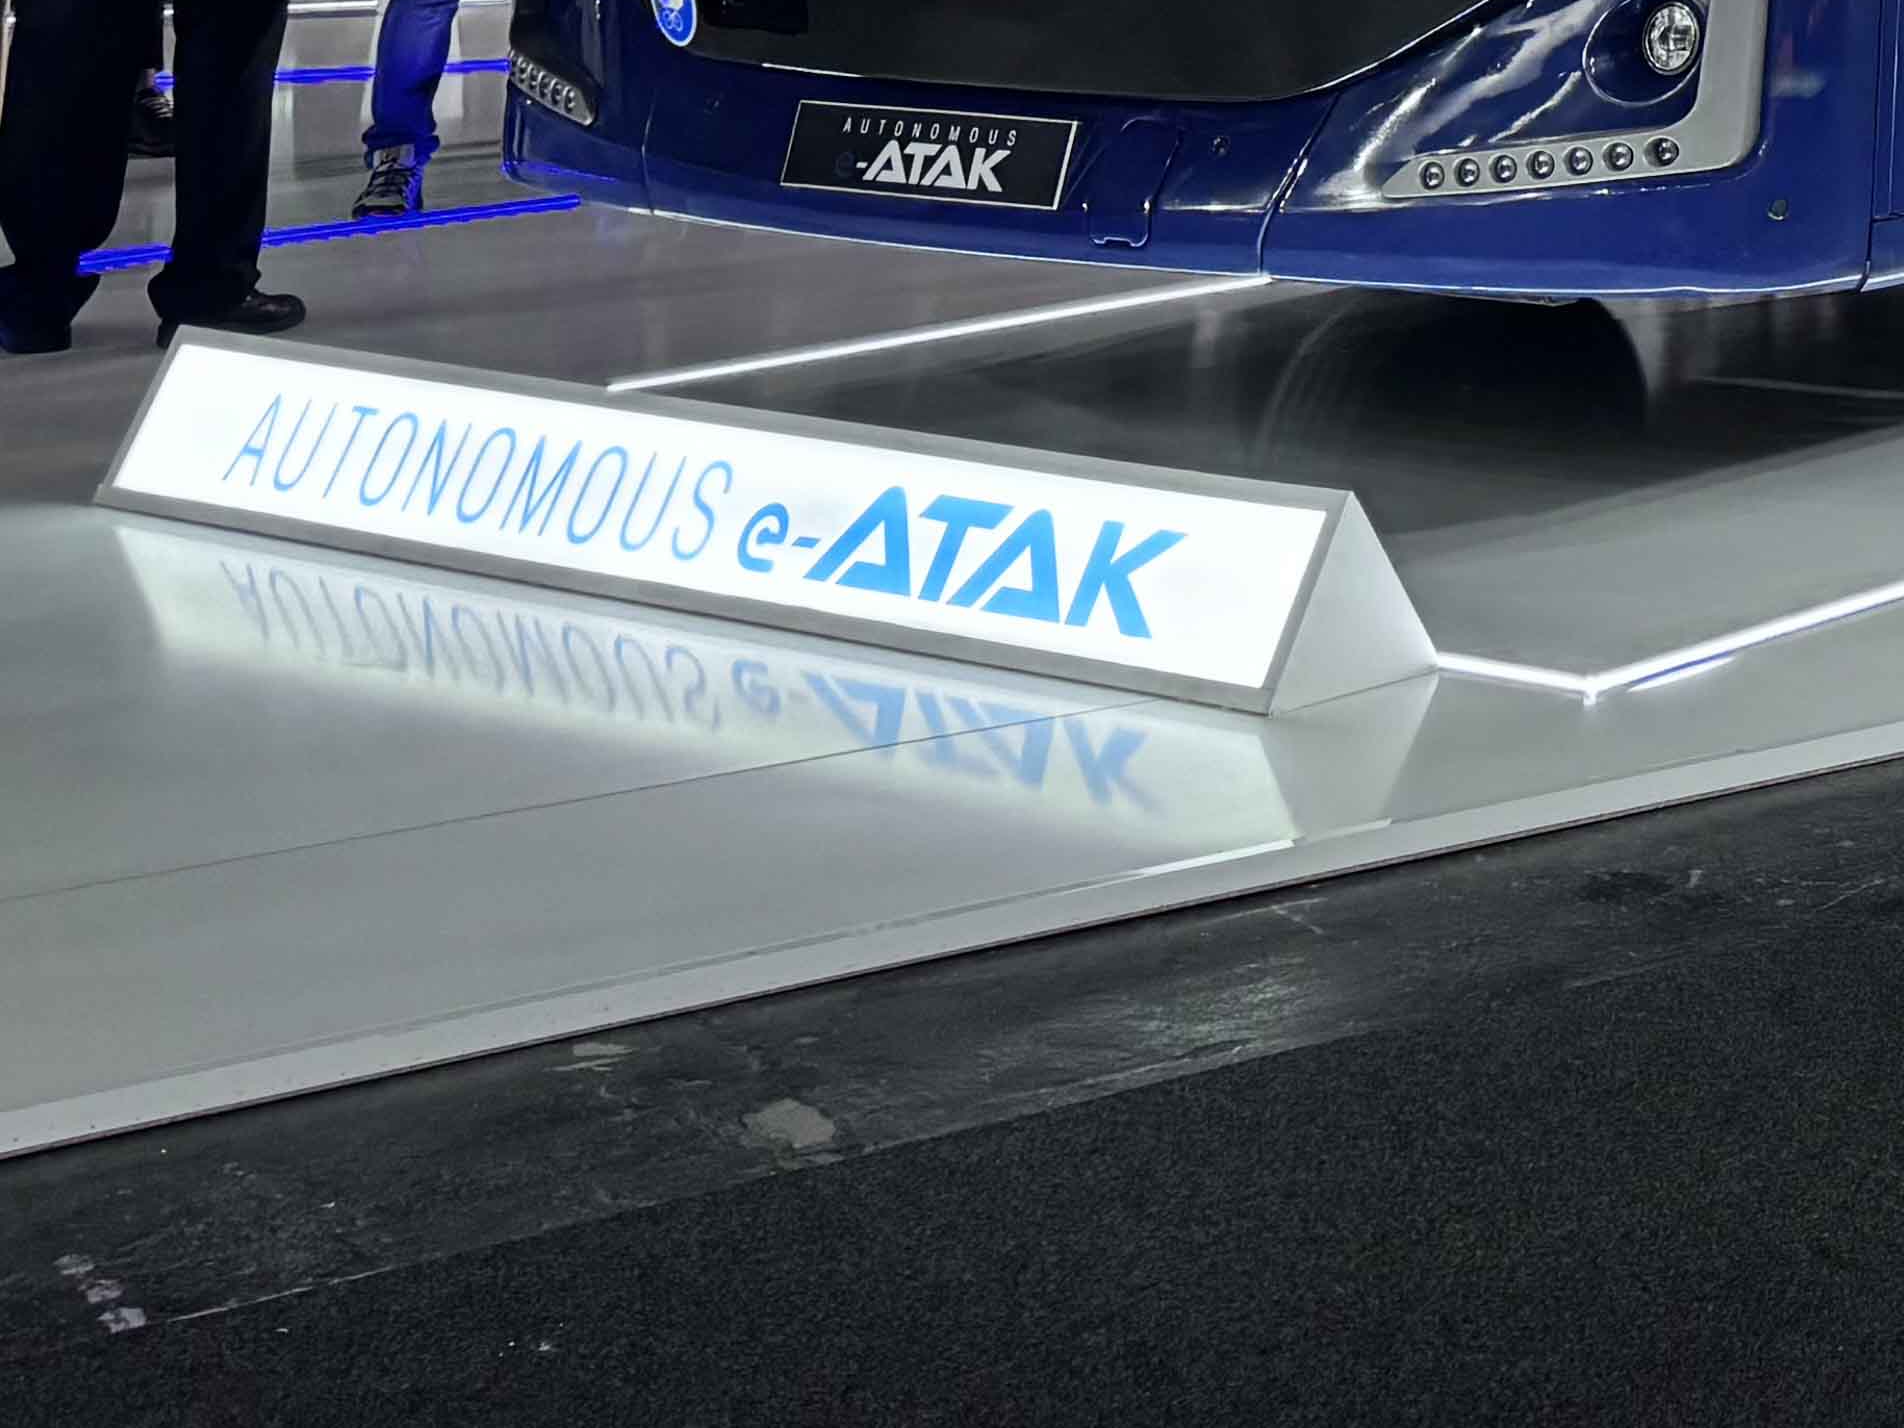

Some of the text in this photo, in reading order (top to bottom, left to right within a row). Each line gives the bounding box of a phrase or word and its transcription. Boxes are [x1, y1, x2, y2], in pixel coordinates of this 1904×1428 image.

[842, 117, 1018, 146] AUTONOMOUS
[222, 394, 1188, 640] AUTONOMOUS e-ATAK
